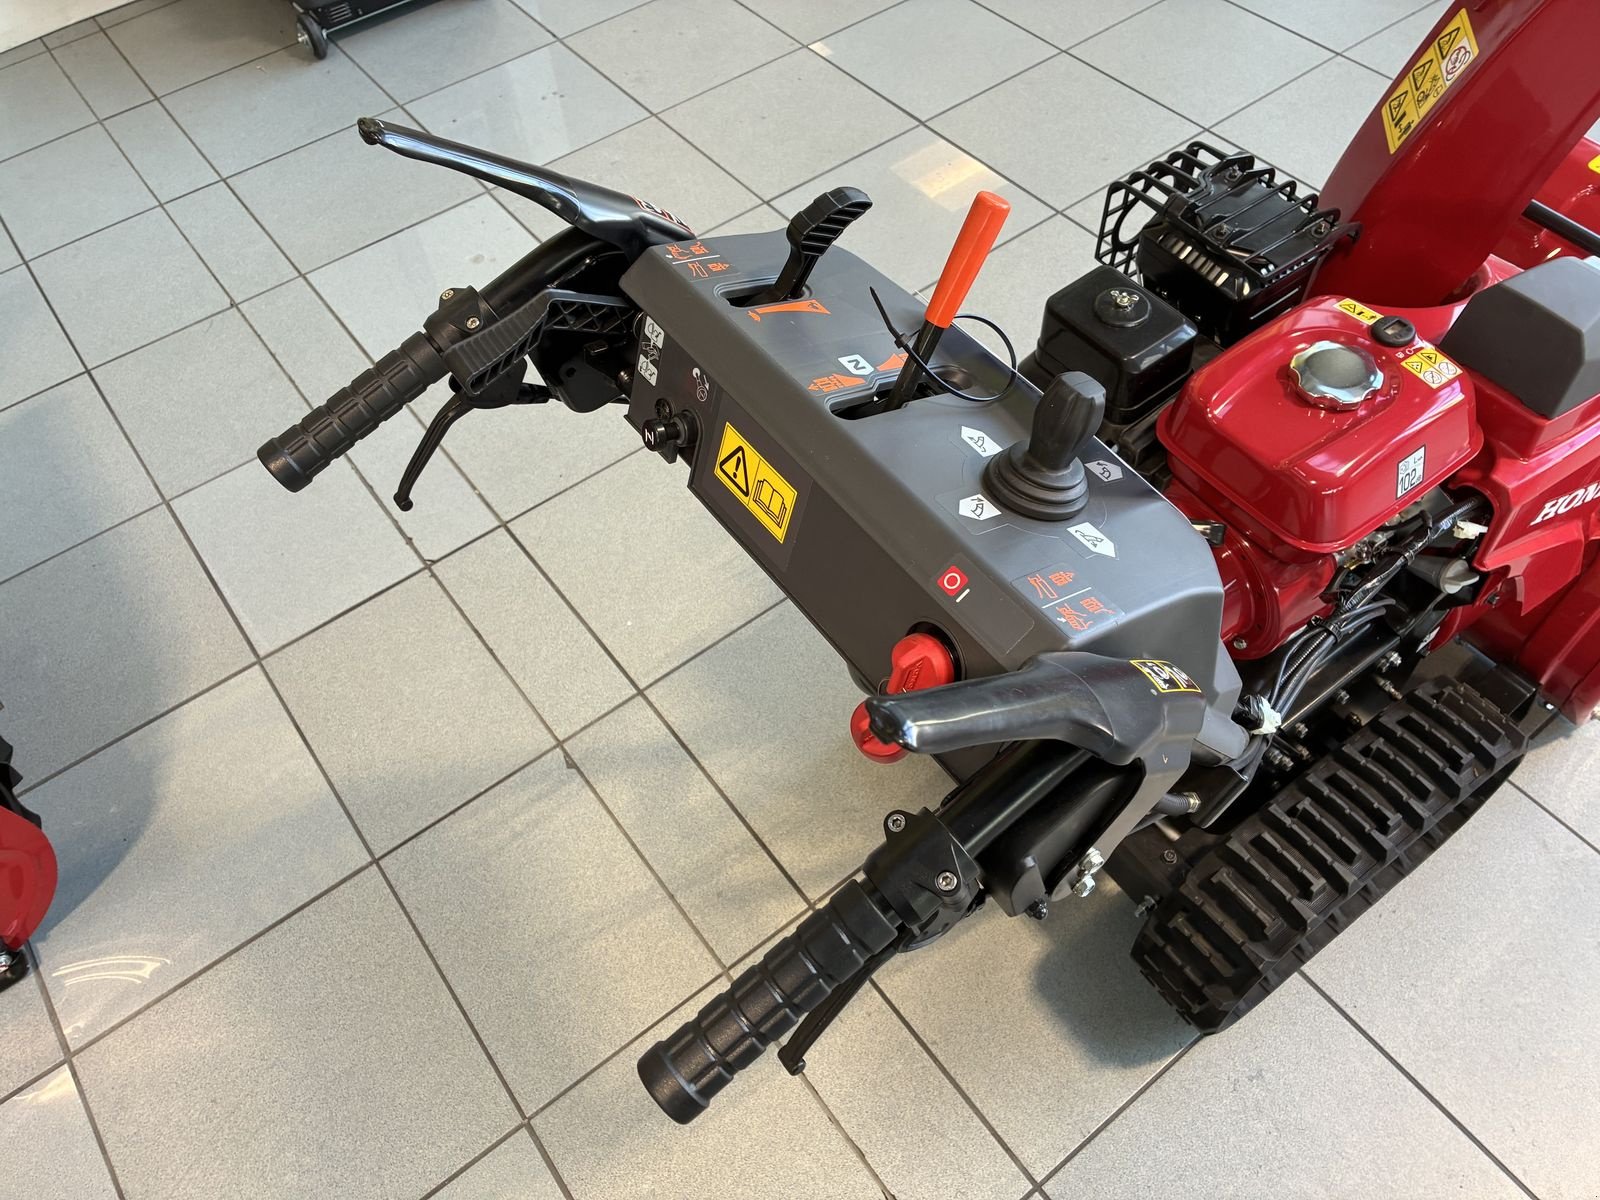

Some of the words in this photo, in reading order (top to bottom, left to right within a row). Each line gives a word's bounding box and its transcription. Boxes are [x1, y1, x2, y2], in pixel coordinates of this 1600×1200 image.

[847, 358, 866, 371] N
[644, 428, 654, 445] N
[1399, 468, 1417, 494] 102
[1528, 482, 1600, 527] HON
